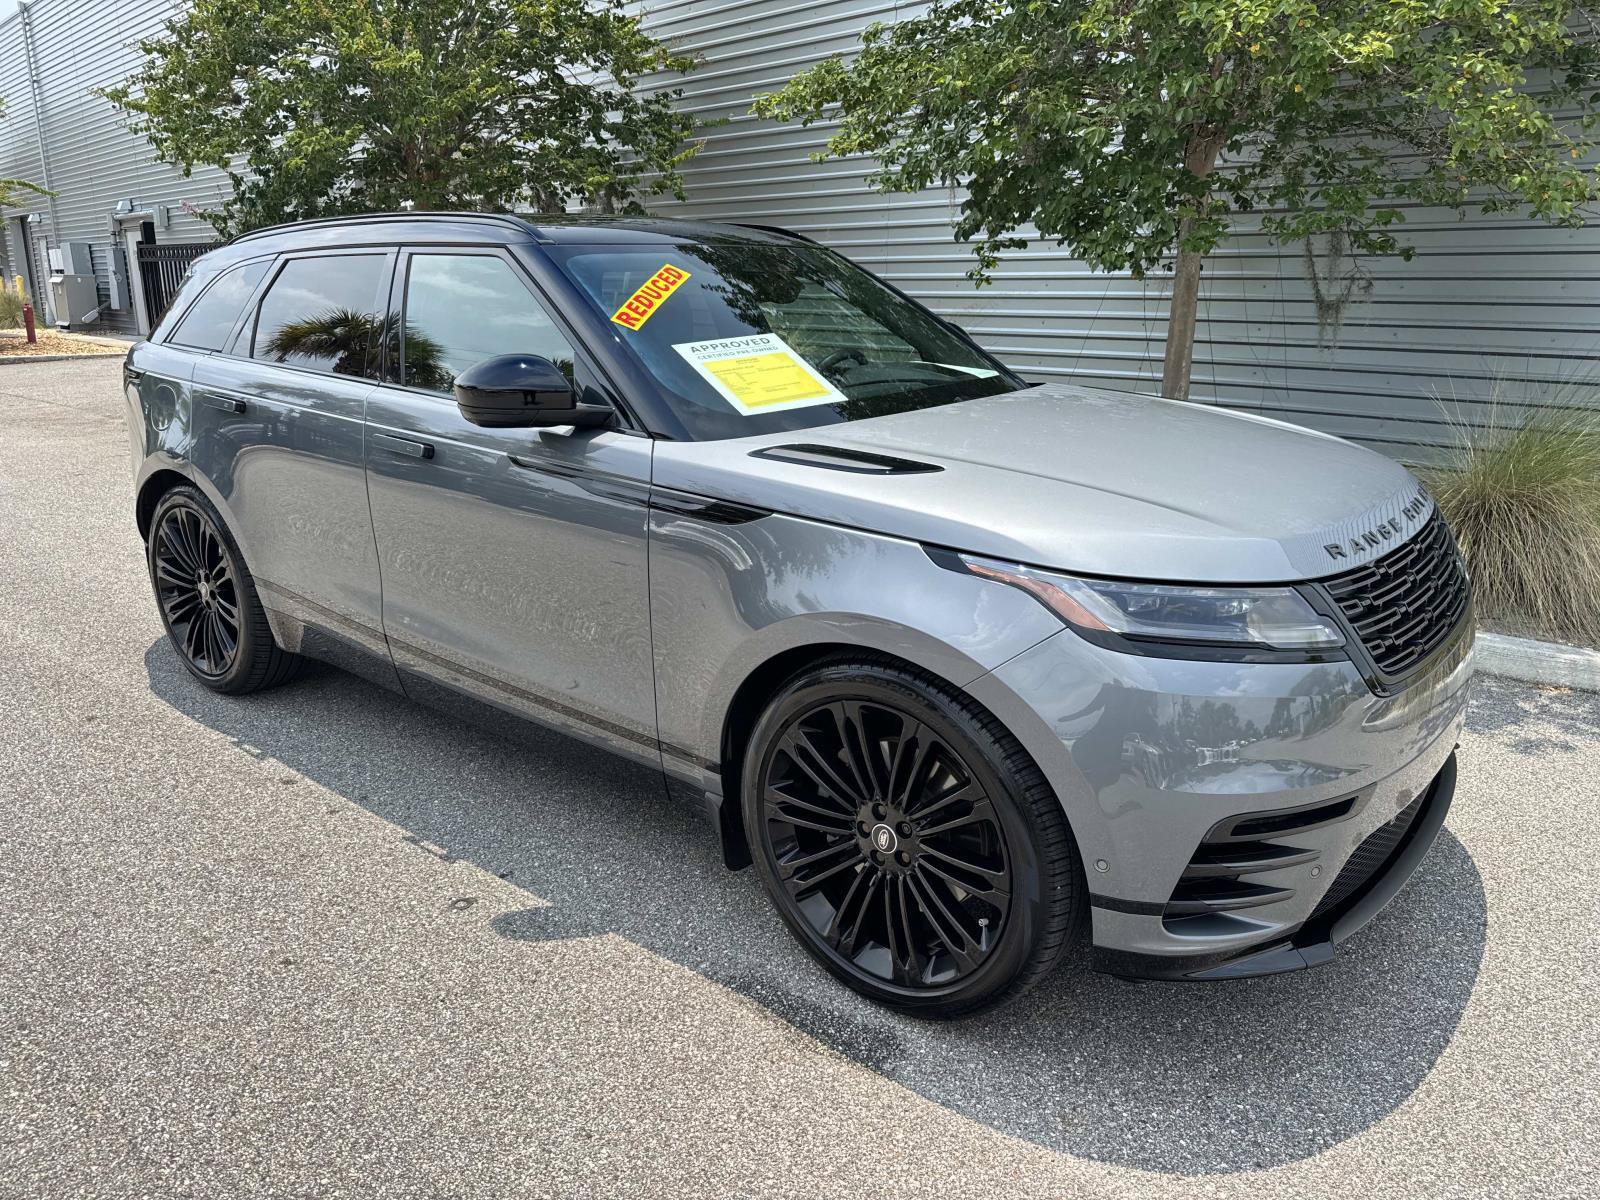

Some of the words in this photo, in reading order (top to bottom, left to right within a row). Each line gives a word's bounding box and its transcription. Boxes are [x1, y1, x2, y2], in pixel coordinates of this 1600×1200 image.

[617, 267, 683, 326] REDUCED
[691, 338, 770, 353] APPROVED
[1324, 518, 1402, 559] RANGE
